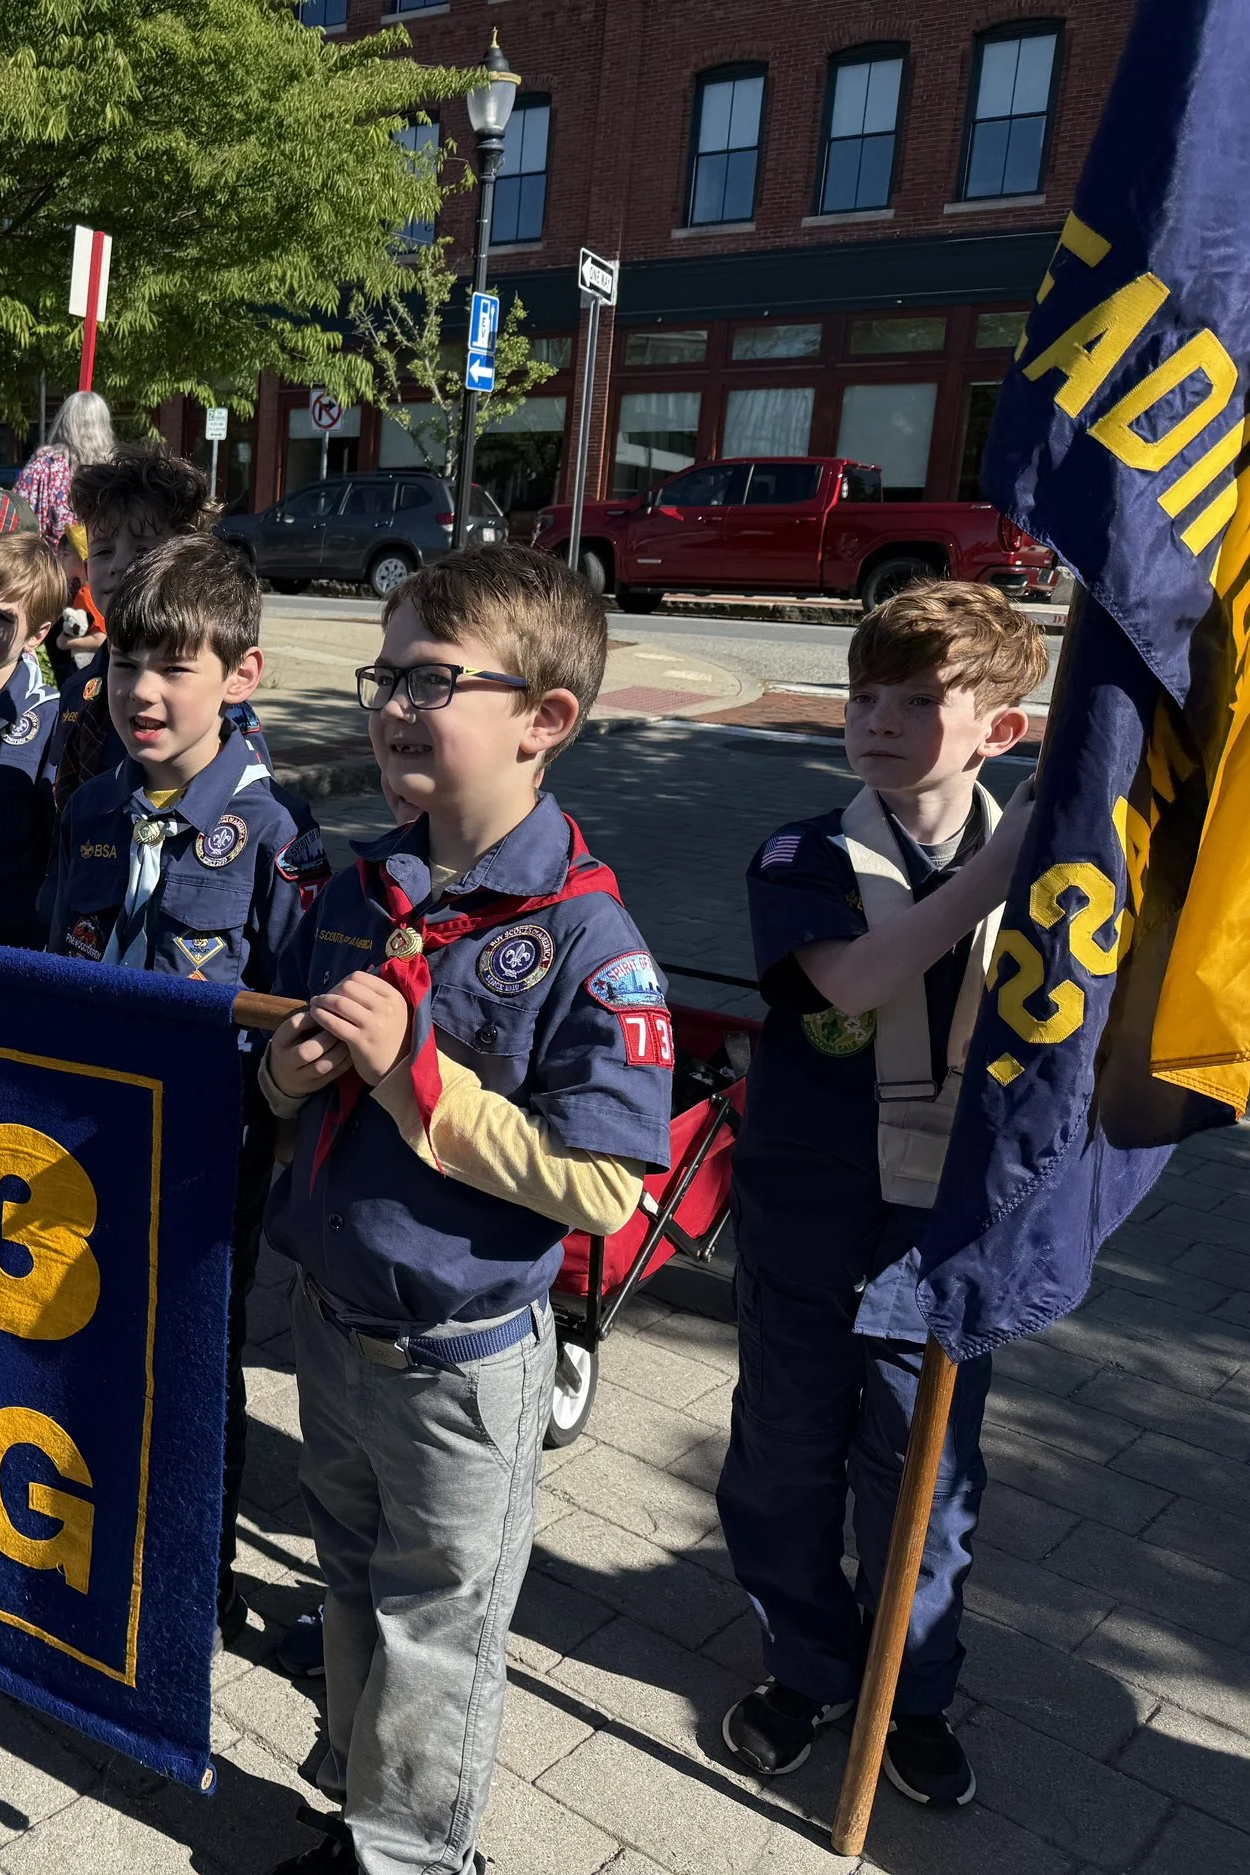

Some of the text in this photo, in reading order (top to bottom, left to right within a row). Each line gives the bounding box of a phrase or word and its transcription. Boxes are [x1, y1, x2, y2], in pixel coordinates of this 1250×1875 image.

[93, 844, 117, 859] BSA
[537, 931, 552, 961] AMERICA
[607, 959, 637, 983] SPIRIT
